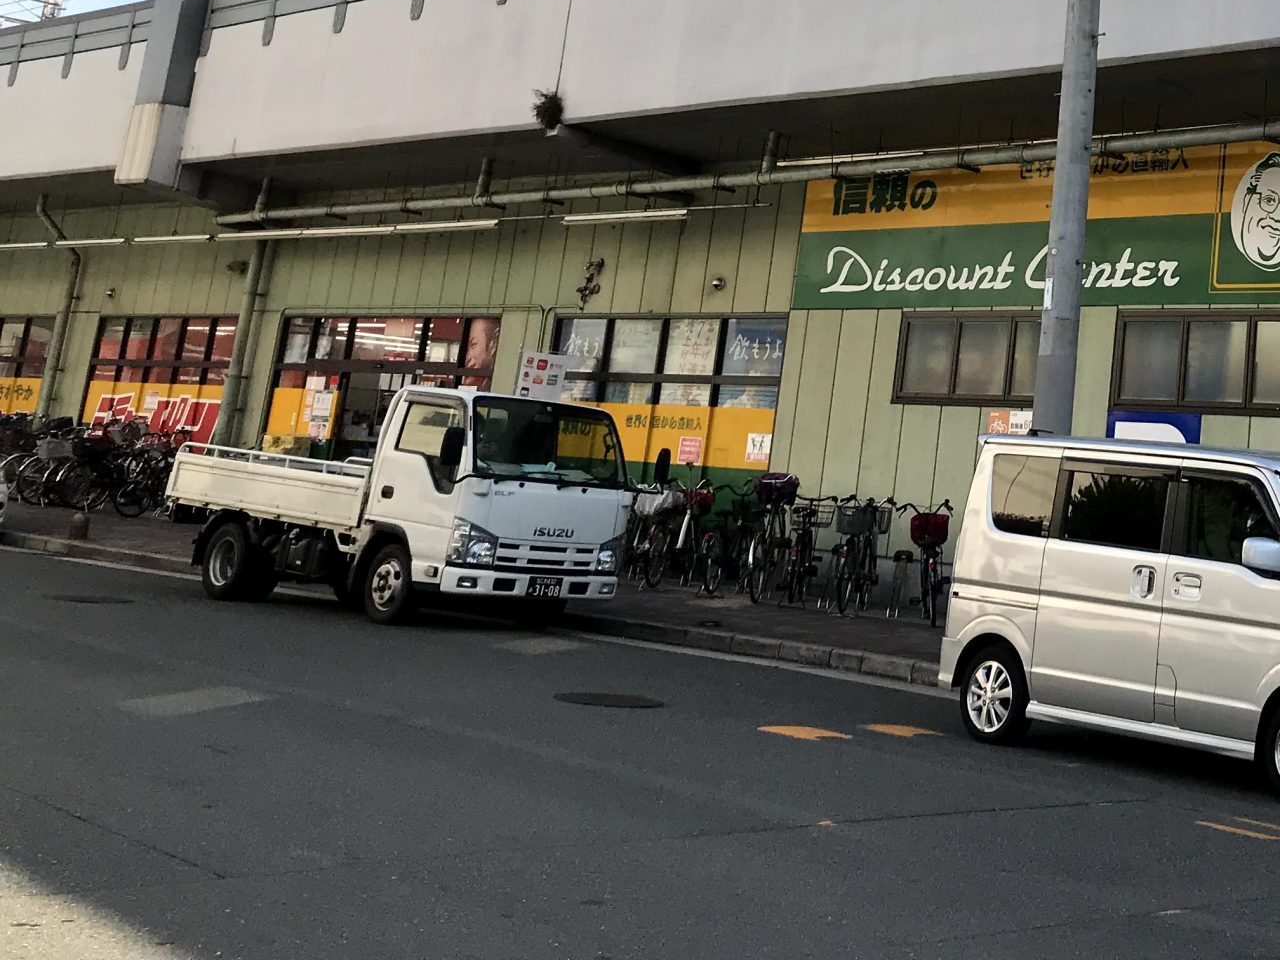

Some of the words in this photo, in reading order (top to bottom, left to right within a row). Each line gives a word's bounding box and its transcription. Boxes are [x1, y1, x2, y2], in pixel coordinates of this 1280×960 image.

[832, 169, 938, 216] 信頼の
[818, 245, 1016, 292] Discount
[1024, 243, 1181, 290] Cnter
[533, 527, 574, 538] ISUZU
[533, 584, 560, 597] 31-08
